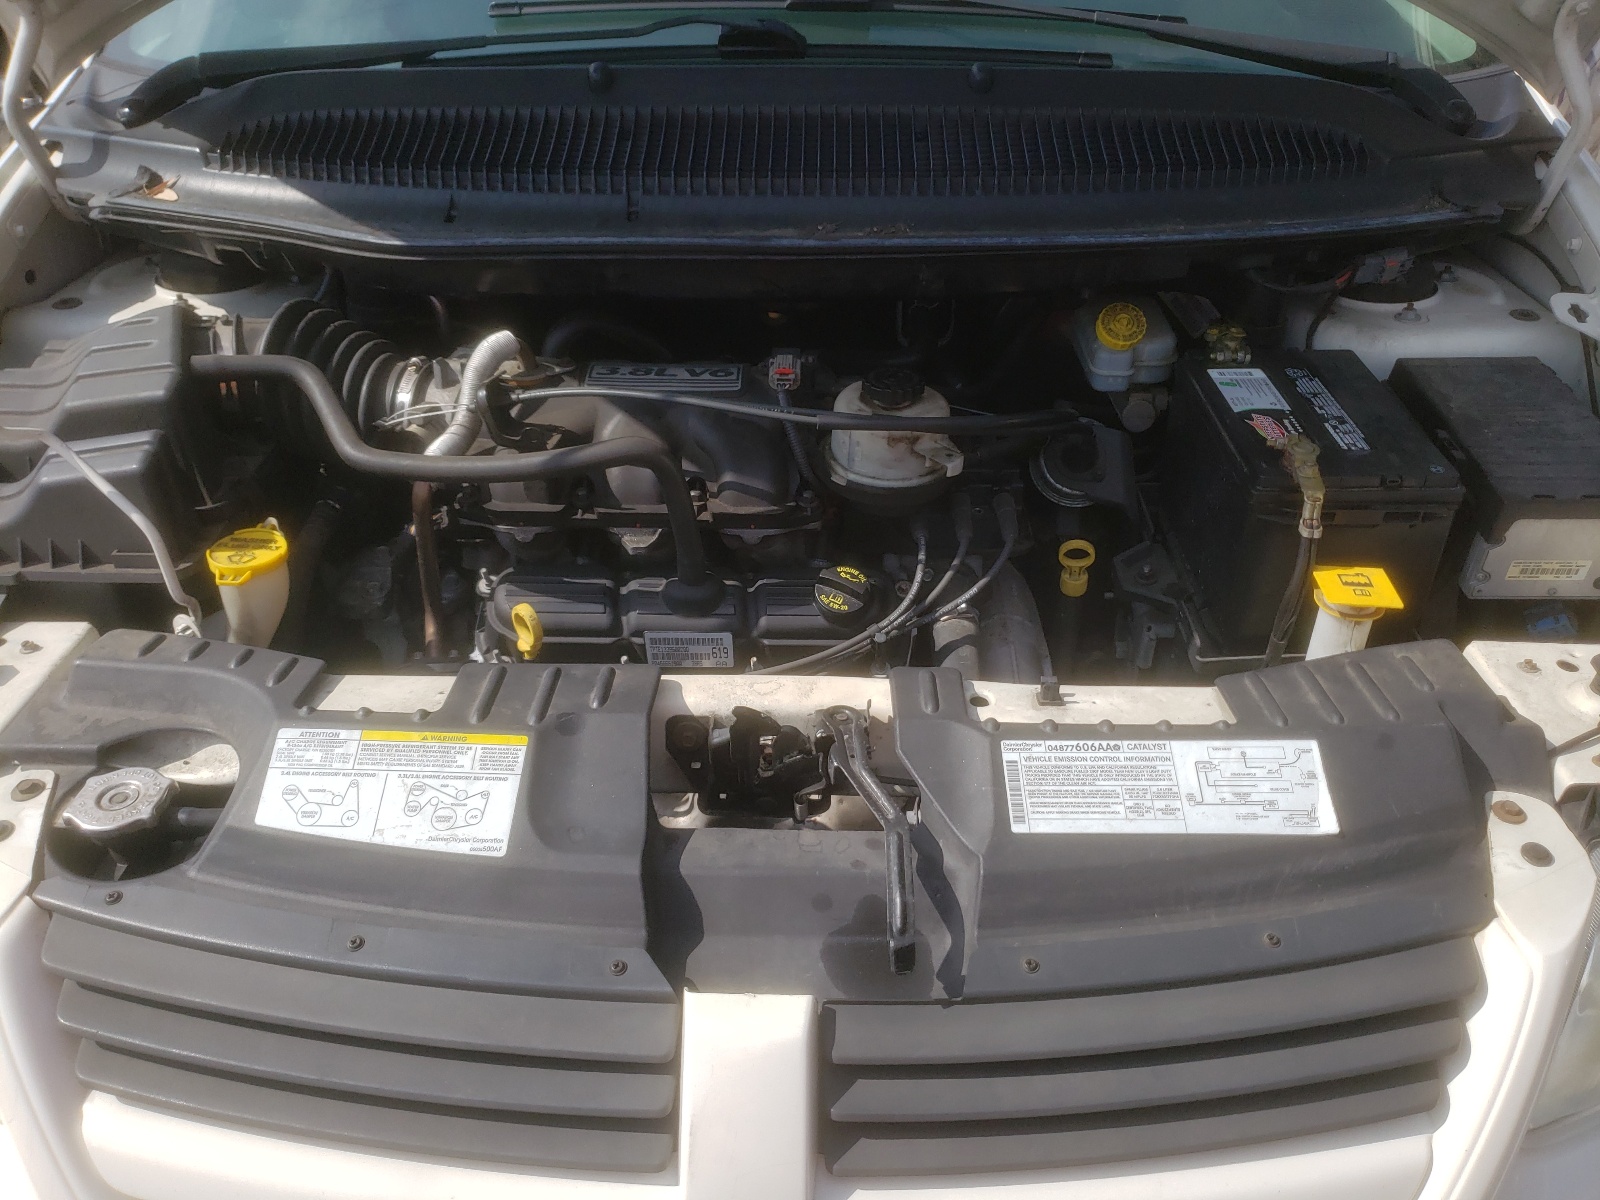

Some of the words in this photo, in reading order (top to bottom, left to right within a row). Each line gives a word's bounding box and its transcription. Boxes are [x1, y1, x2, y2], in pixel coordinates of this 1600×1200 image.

[596, 366, 678, 377] 3.8L
[684, 367, 735, 378] V6
[836, 566, 860, 576] ENGINE
[858, 574, 868, 583] OIL
[820, 594, 830, 604] SAE
[958, 588, 978, 604] DENSO
[712, 646, 729, 658] 619
[1048, 742, 1112, 752] 04877606AA
